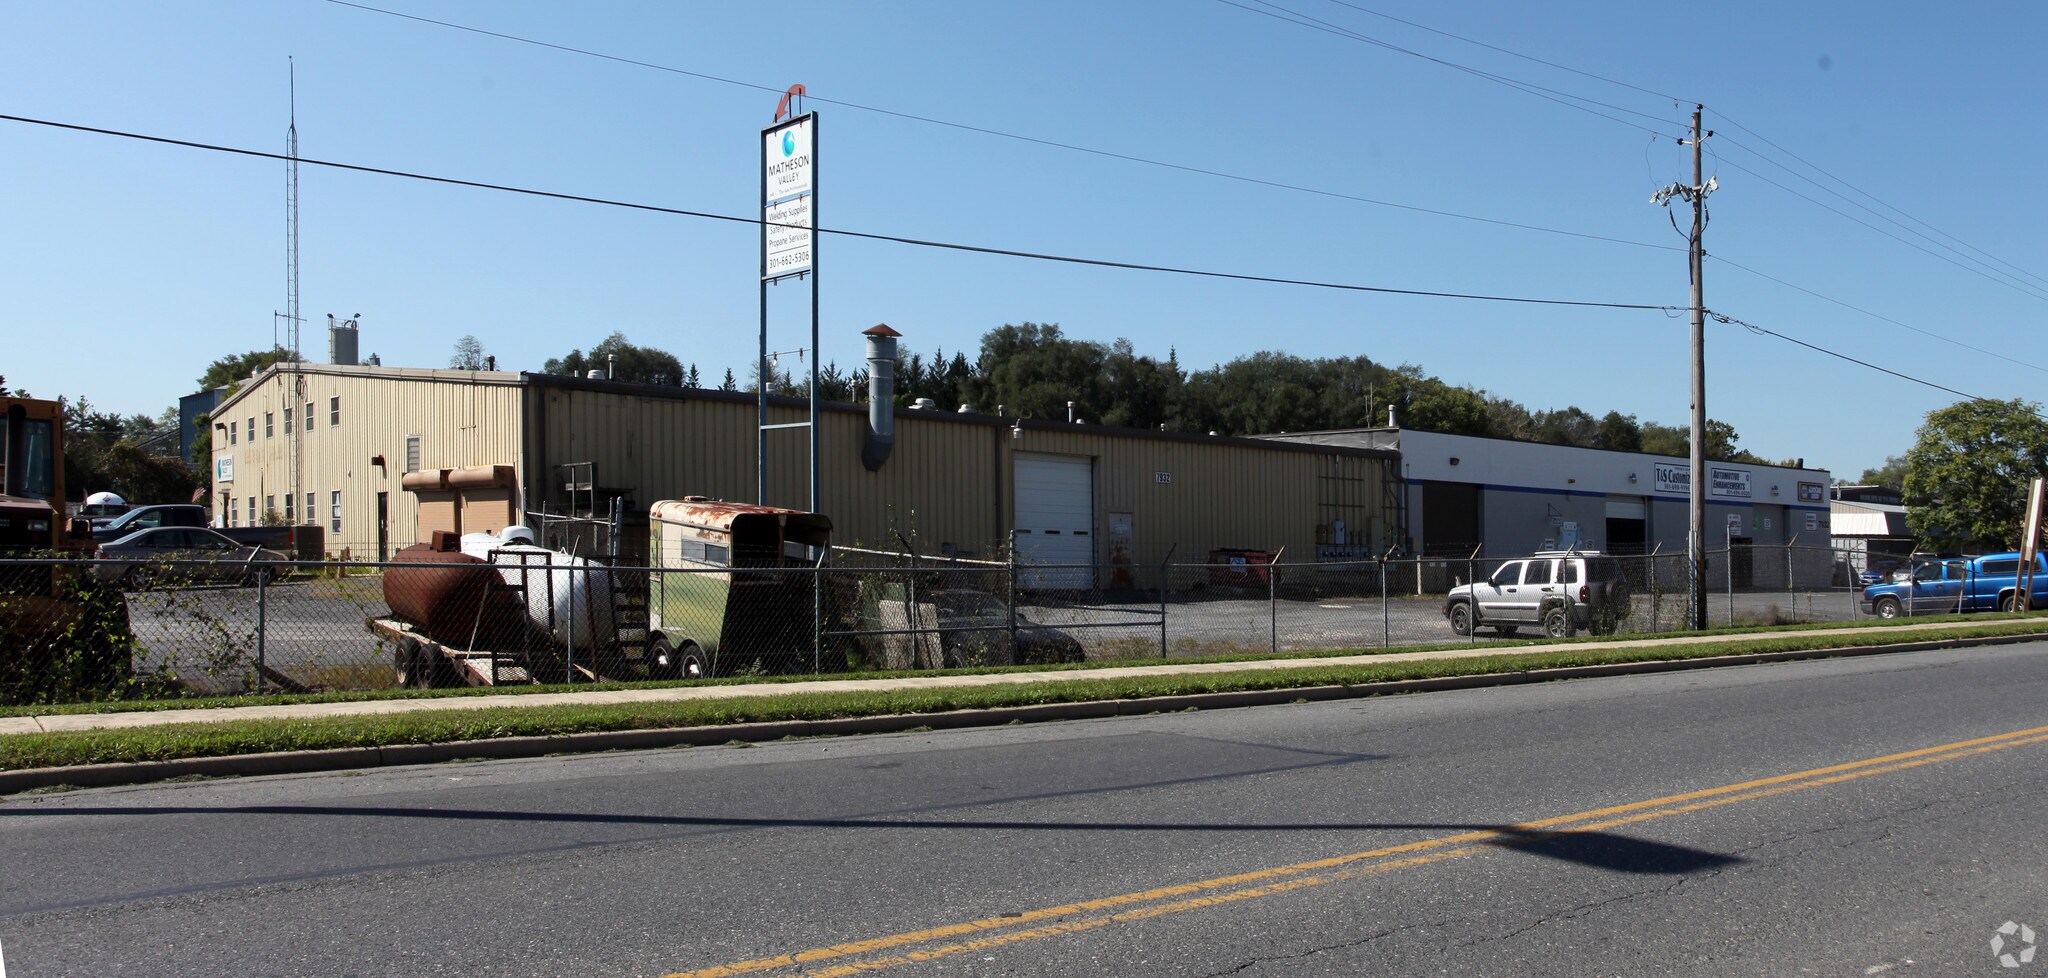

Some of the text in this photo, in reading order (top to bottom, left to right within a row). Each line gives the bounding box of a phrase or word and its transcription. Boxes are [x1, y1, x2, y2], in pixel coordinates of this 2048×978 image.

[769, 154, 809, 176] MATHESON
[778, 171, 799, 185] VALLEY
[769, 204, 808, 221] Welding Supplies
[770, 223, 785, 235] Safety
[769, 232, 808, 248] Propane Services
[769, 251, 810, 269] 301-662-5306
